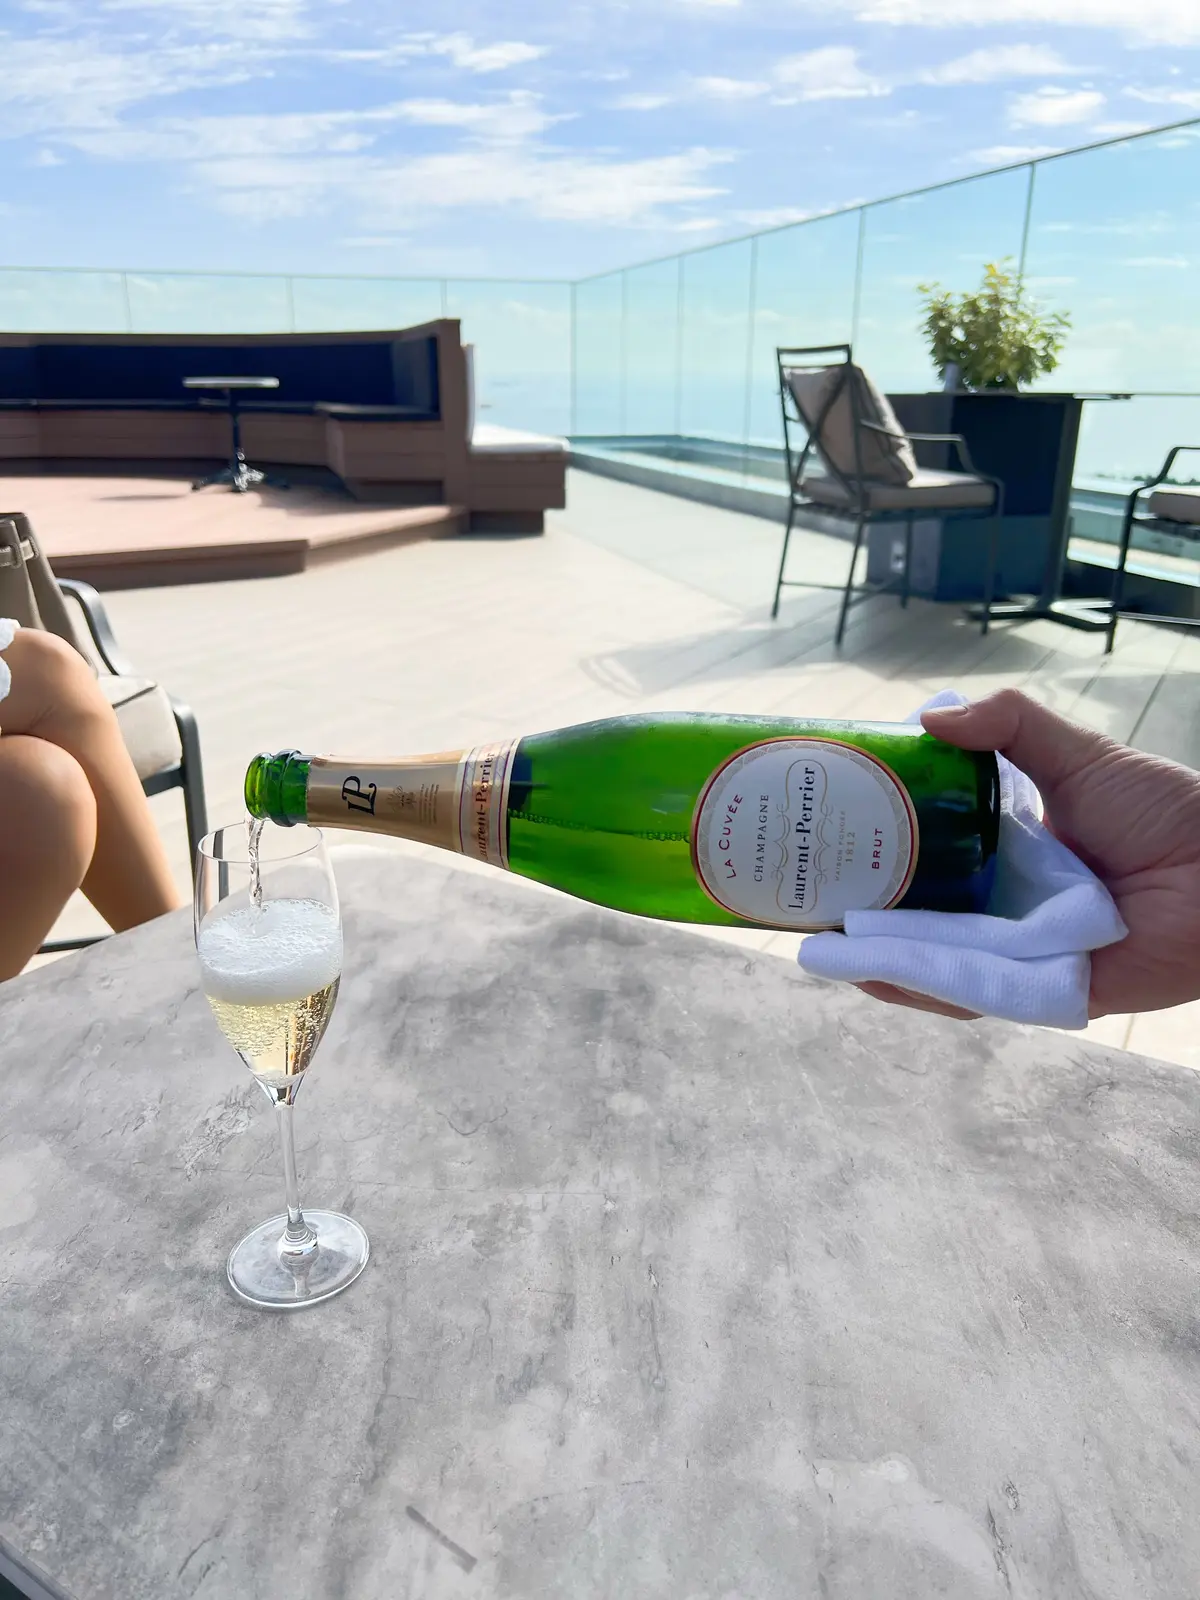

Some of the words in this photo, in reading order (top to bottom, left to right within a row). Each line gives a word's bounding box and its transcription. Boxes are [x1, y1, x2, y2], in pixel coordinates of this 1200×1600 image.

[474, 752, 495, 860] aurent-Perrier
[753, 794, 769, 882] CHAMPAGNE
[788, 767, 816, 909] Laurent-Perrier
[845, 831, 856, 863] 1812
[871, 828, 884, 869] BRUT
[725, 858, 737, 879] LA
[834, 849, 843, 881] MAISON
